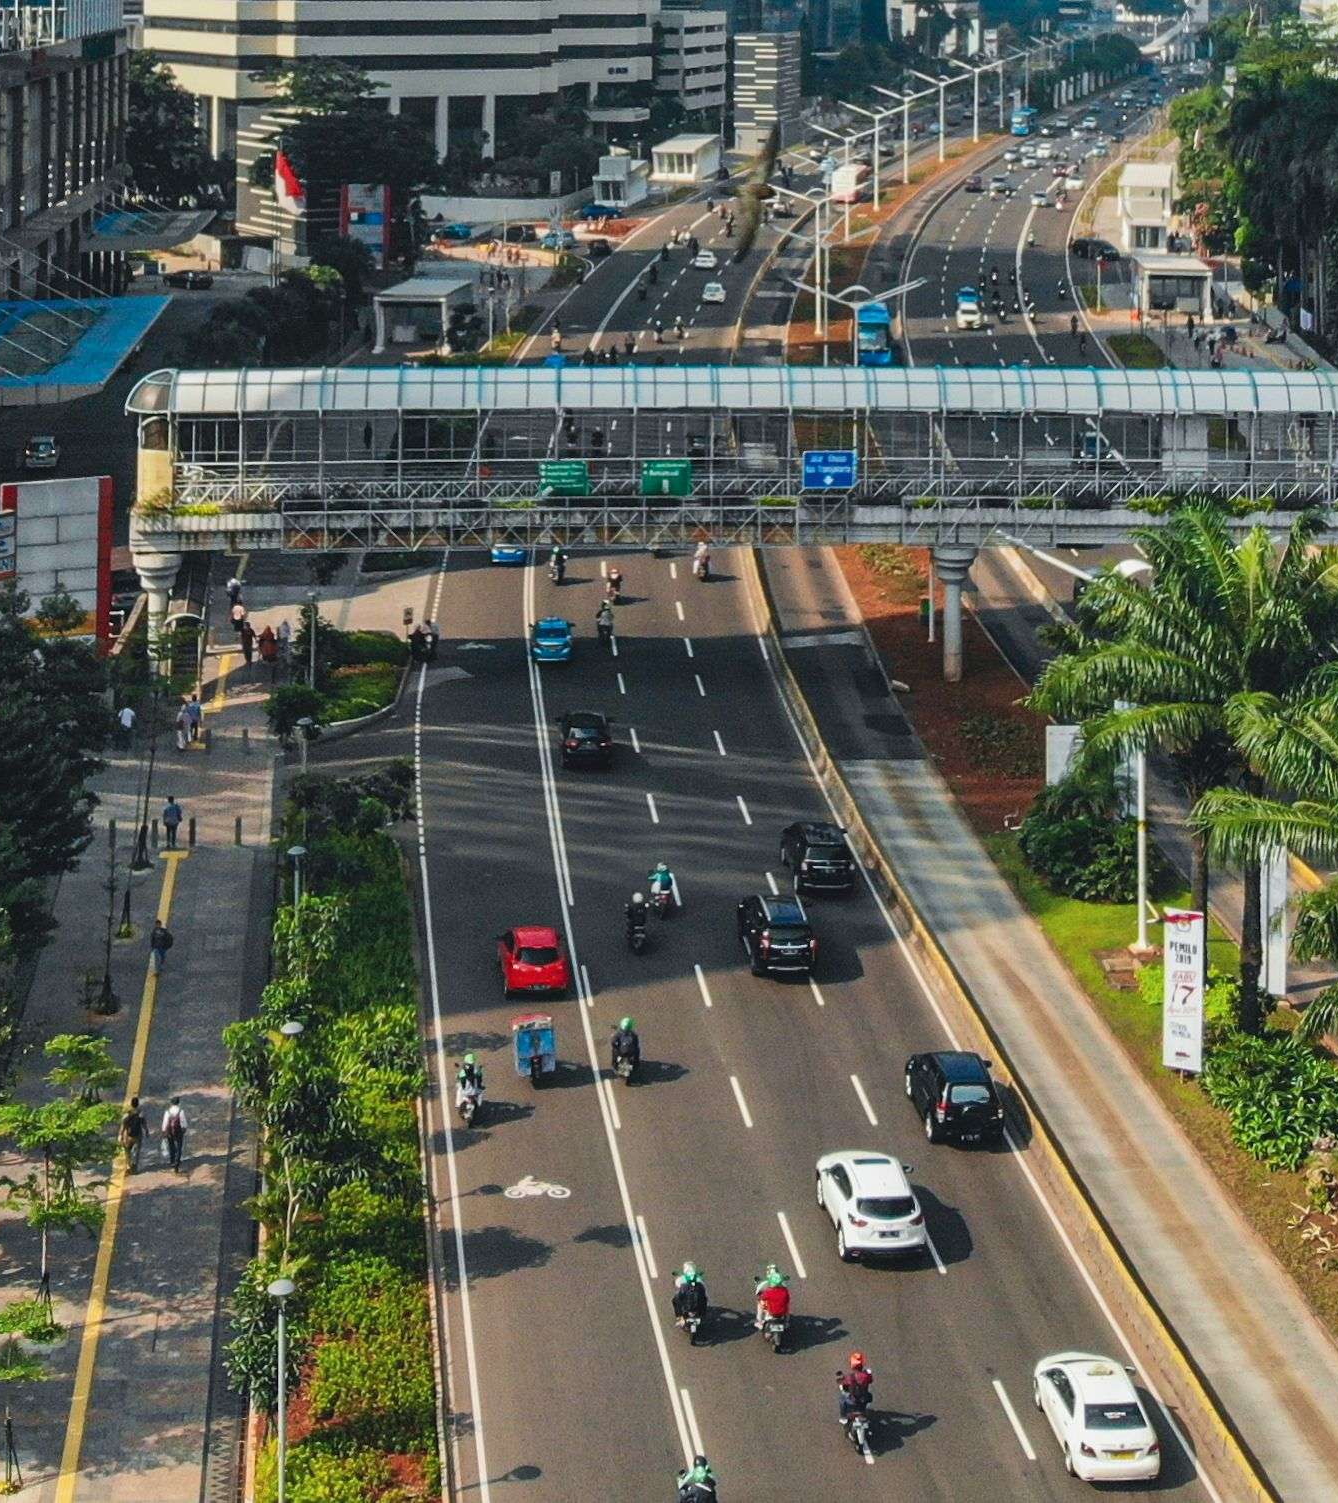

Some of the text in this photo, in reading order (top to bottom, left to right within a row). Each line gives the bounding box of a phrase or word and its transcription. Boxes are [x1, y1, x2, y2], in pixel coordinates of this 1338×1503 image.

[1170, 941, 1197, 955] PEMILU
[1175, 952, 1191, 965] 2019
[1172, 983, 1195, 1006] 17
